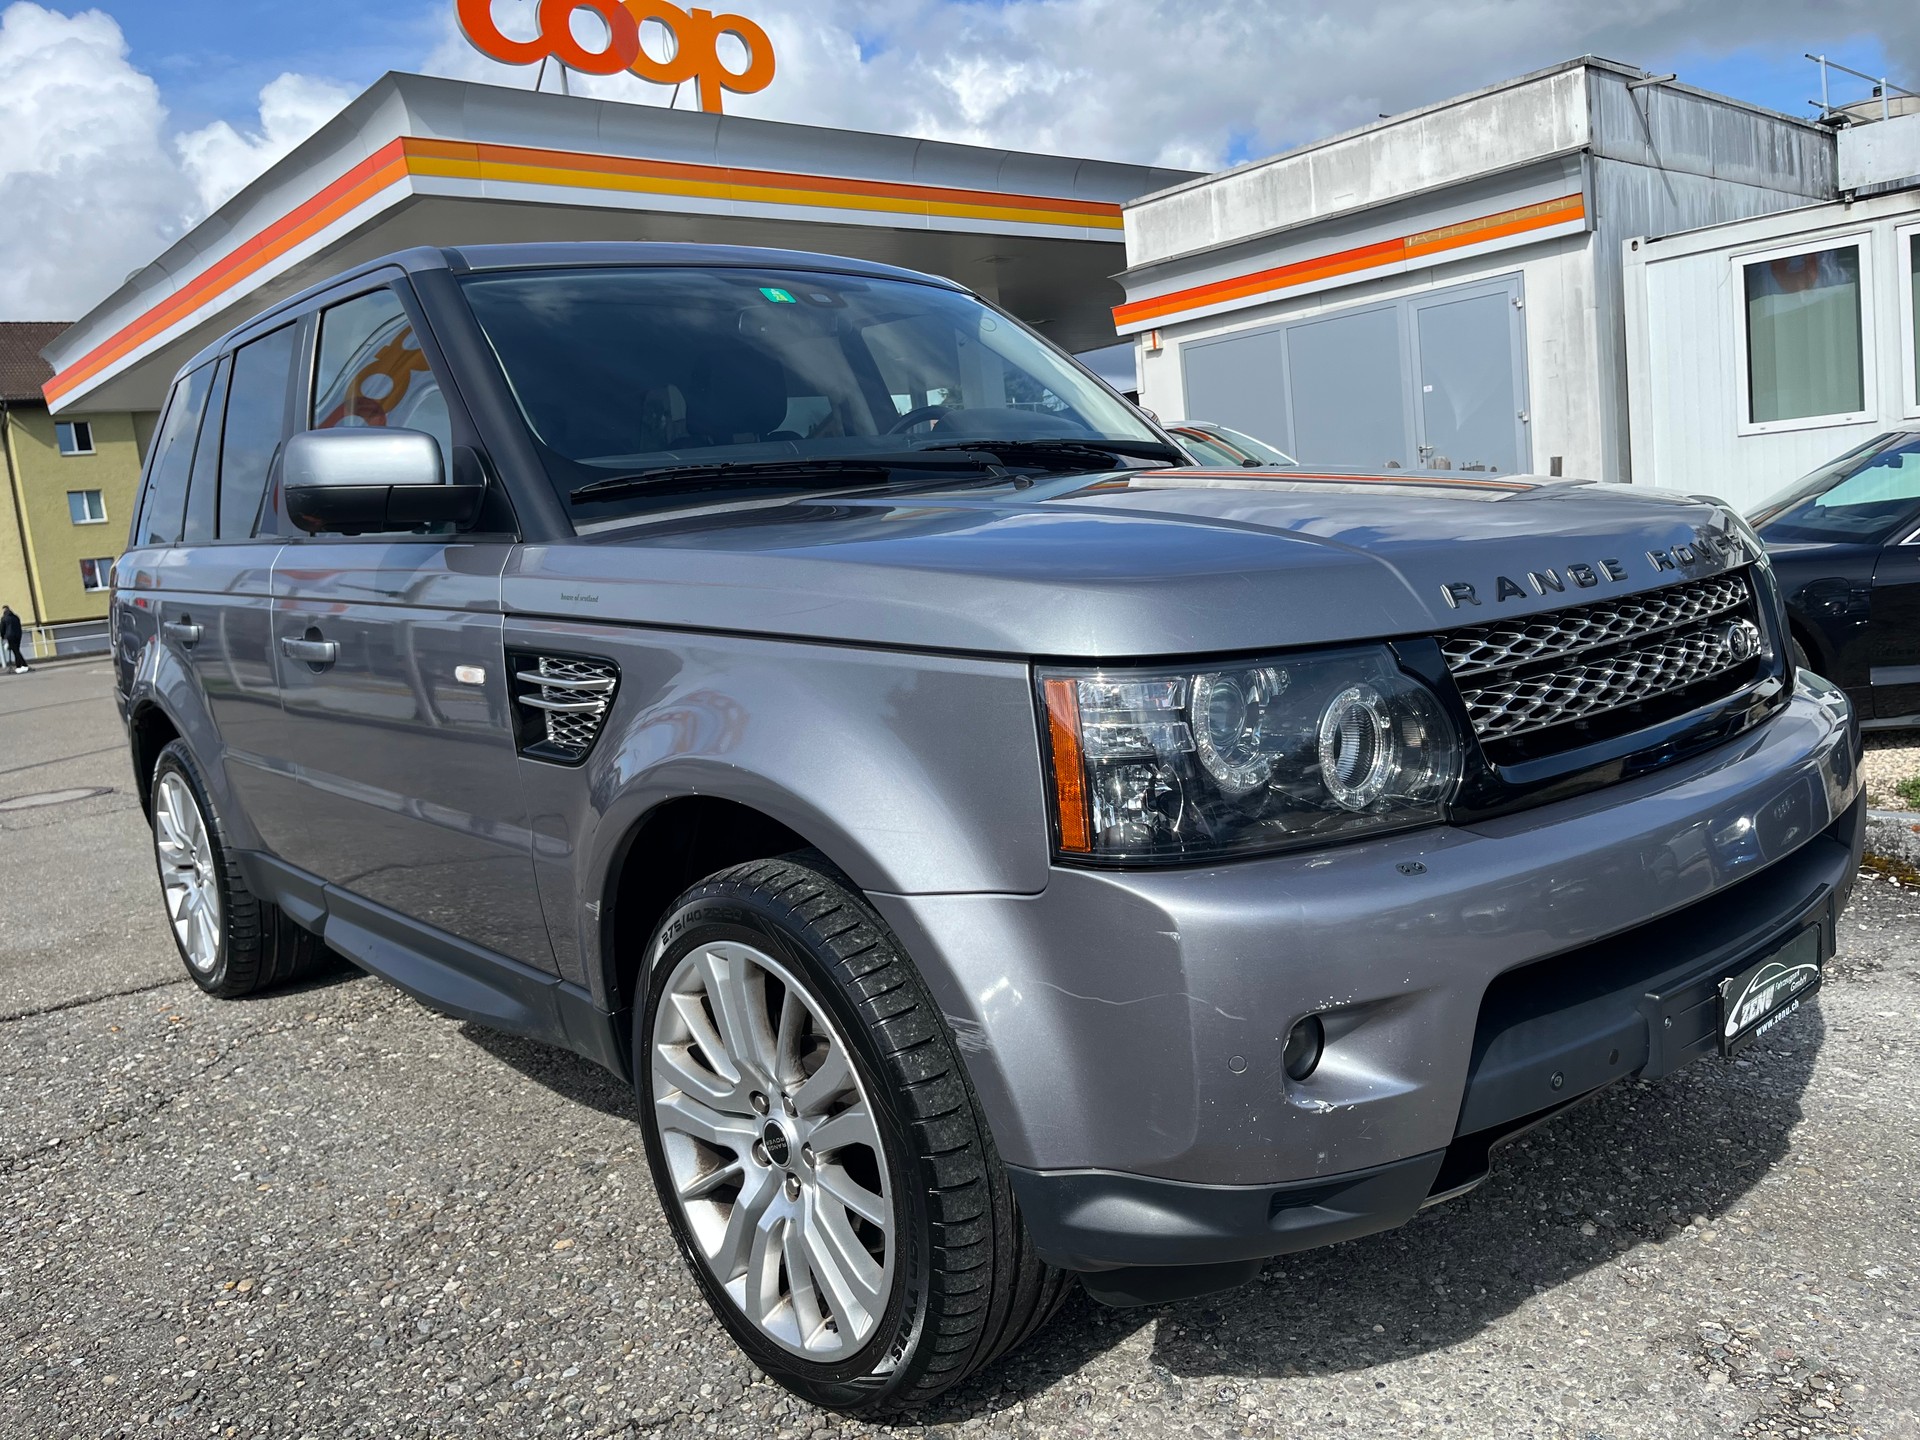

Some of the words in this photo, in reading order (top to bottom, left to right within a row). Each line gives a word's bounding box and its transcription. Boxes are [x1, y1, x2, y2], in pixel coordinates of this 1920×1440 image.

[443, 0, 775, 115] coop
[1440, 558, 1629, 609] RANGE
[661, 909, 703, 946] 275/40
[1740, 983, 1775, 1029] ZENU
[1755, 999, 1800, 1037] www.zenu.ch
